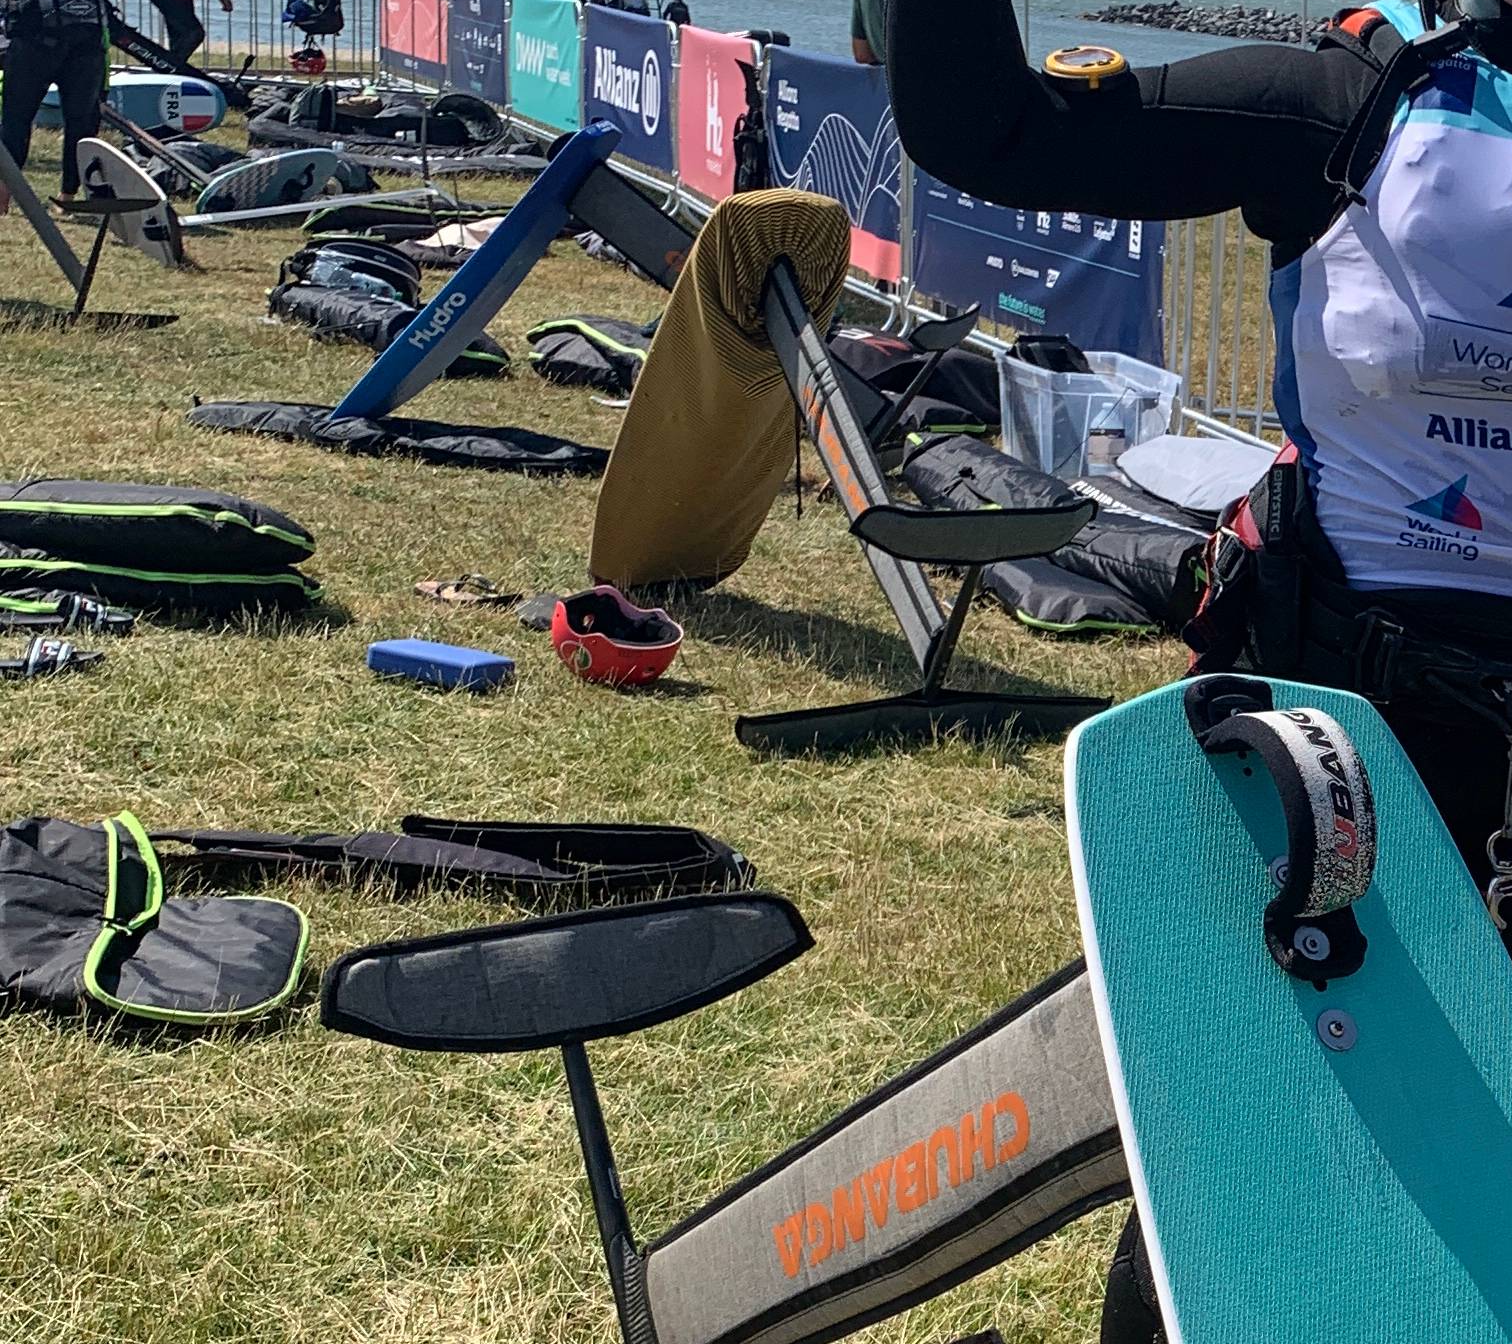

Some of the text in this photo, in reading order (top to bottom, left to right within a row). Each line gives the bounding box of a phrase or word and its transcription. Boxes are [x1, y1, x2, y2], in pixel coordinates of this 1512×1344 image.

[166, 90, 180, 121] FRA
[592, 46, 641, 114] Allianz
[407, 291, 468, 351] Hydro
[1270, 482, 1282, 533] MYSTIC
[1395, 531, 1480, 561] Sailing
[771, 1090, 1031, 1279] CHUBANGA
